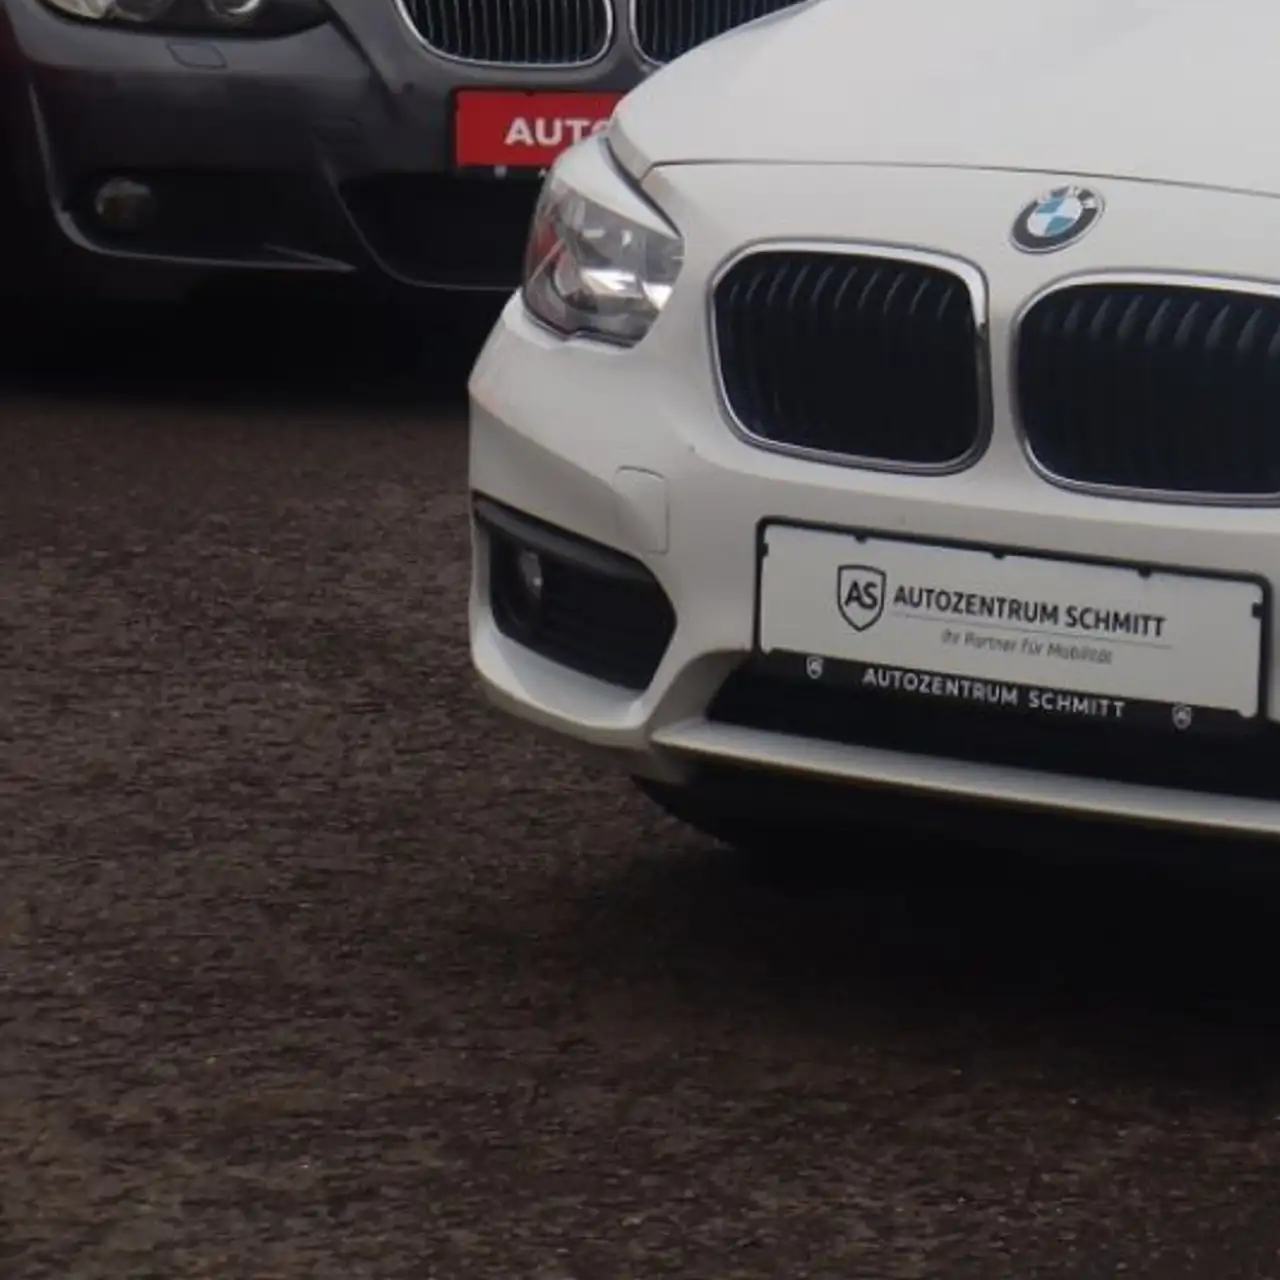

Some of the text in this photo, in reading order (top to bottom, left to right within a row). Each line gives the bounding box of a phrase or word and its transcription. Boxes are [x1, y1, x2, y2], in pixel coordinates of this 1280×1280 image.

[844, 579, 879, 611] AS
[893, 584, 1167, 638] AUTOZENTRUM SCHMITT
[861, 667, 1018, 706] AUTOZENTRUM
[1028, 691, 1126, 719] SCHMITT
